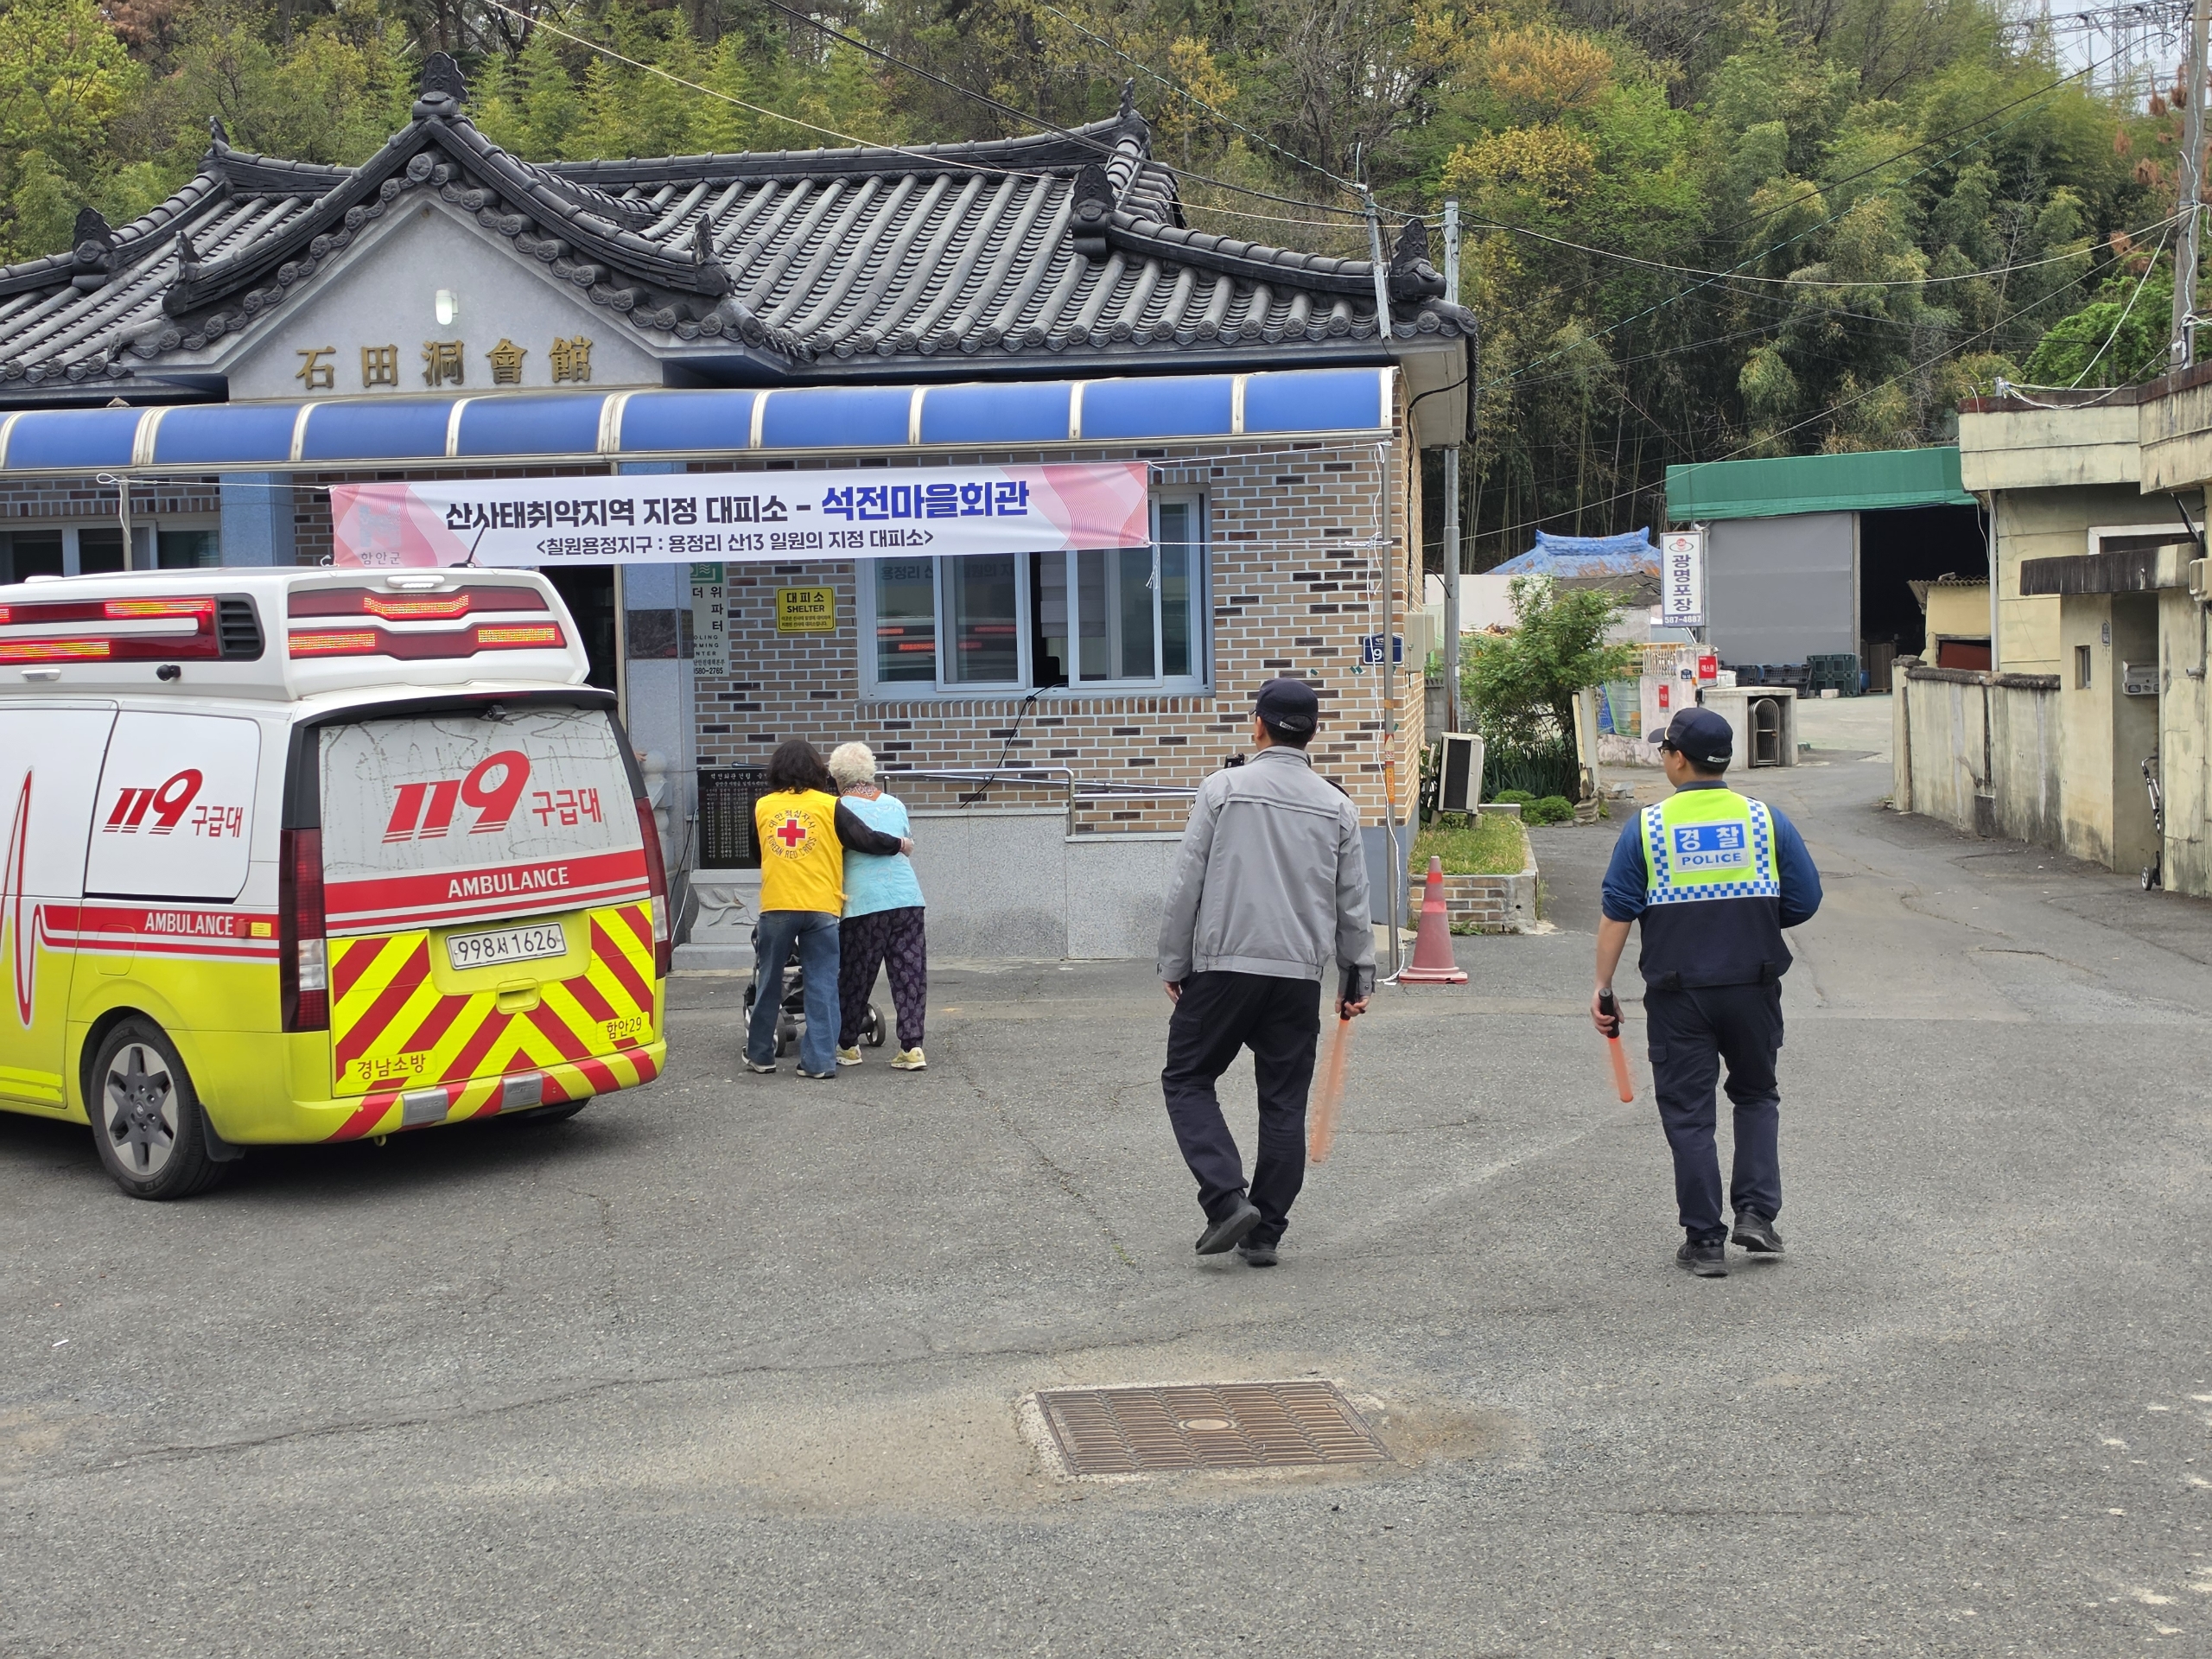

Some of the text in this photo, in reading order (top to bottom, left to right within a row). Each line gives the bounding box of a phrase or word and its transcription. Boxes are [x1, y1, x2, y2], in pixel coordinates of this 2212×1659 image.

[296, 335, 594, 390] 石田洞會館
[446, 499, 634, 530] 산사태취약지역
[643, 497, 697, 525] 지정
[706, 495, 788, 524] 대피소
[822, 480, 1029, 521] 석전마을회관
[537, 536, 652, 556] <칠원용정지구
[669, 534, 721, 553] 용정리
[728, 533, 764, 552] 산13
[770, 531, 823, 550] 일원의
[829, 530, 864, 549] 지정
[870, 529, 934, 548] 대피소>
[361, 551, 401, 565] 함안군
[1672, 554, 1693, 612] 광명포장
[786, 592, 824, 603] 대피소
[102, 768, 244, 838] 119 구급대
[381, 750, 602, 843] 119 구급대
[769, 810, 816, 829] 대한적십자사
[767, 835, 817, 859] KOREAN RED CROSS
[1679, 826, 1738, 851] 경찰
[1681, 852, 1742, 866] POLICE
[448, 867, 569, 899] AMBULANCE
[144, 912, 234, 936] AMBULANCE
[606, 1015, 642, 1039] 함안29
[357, 1052, 426, 1073] 경남소방
